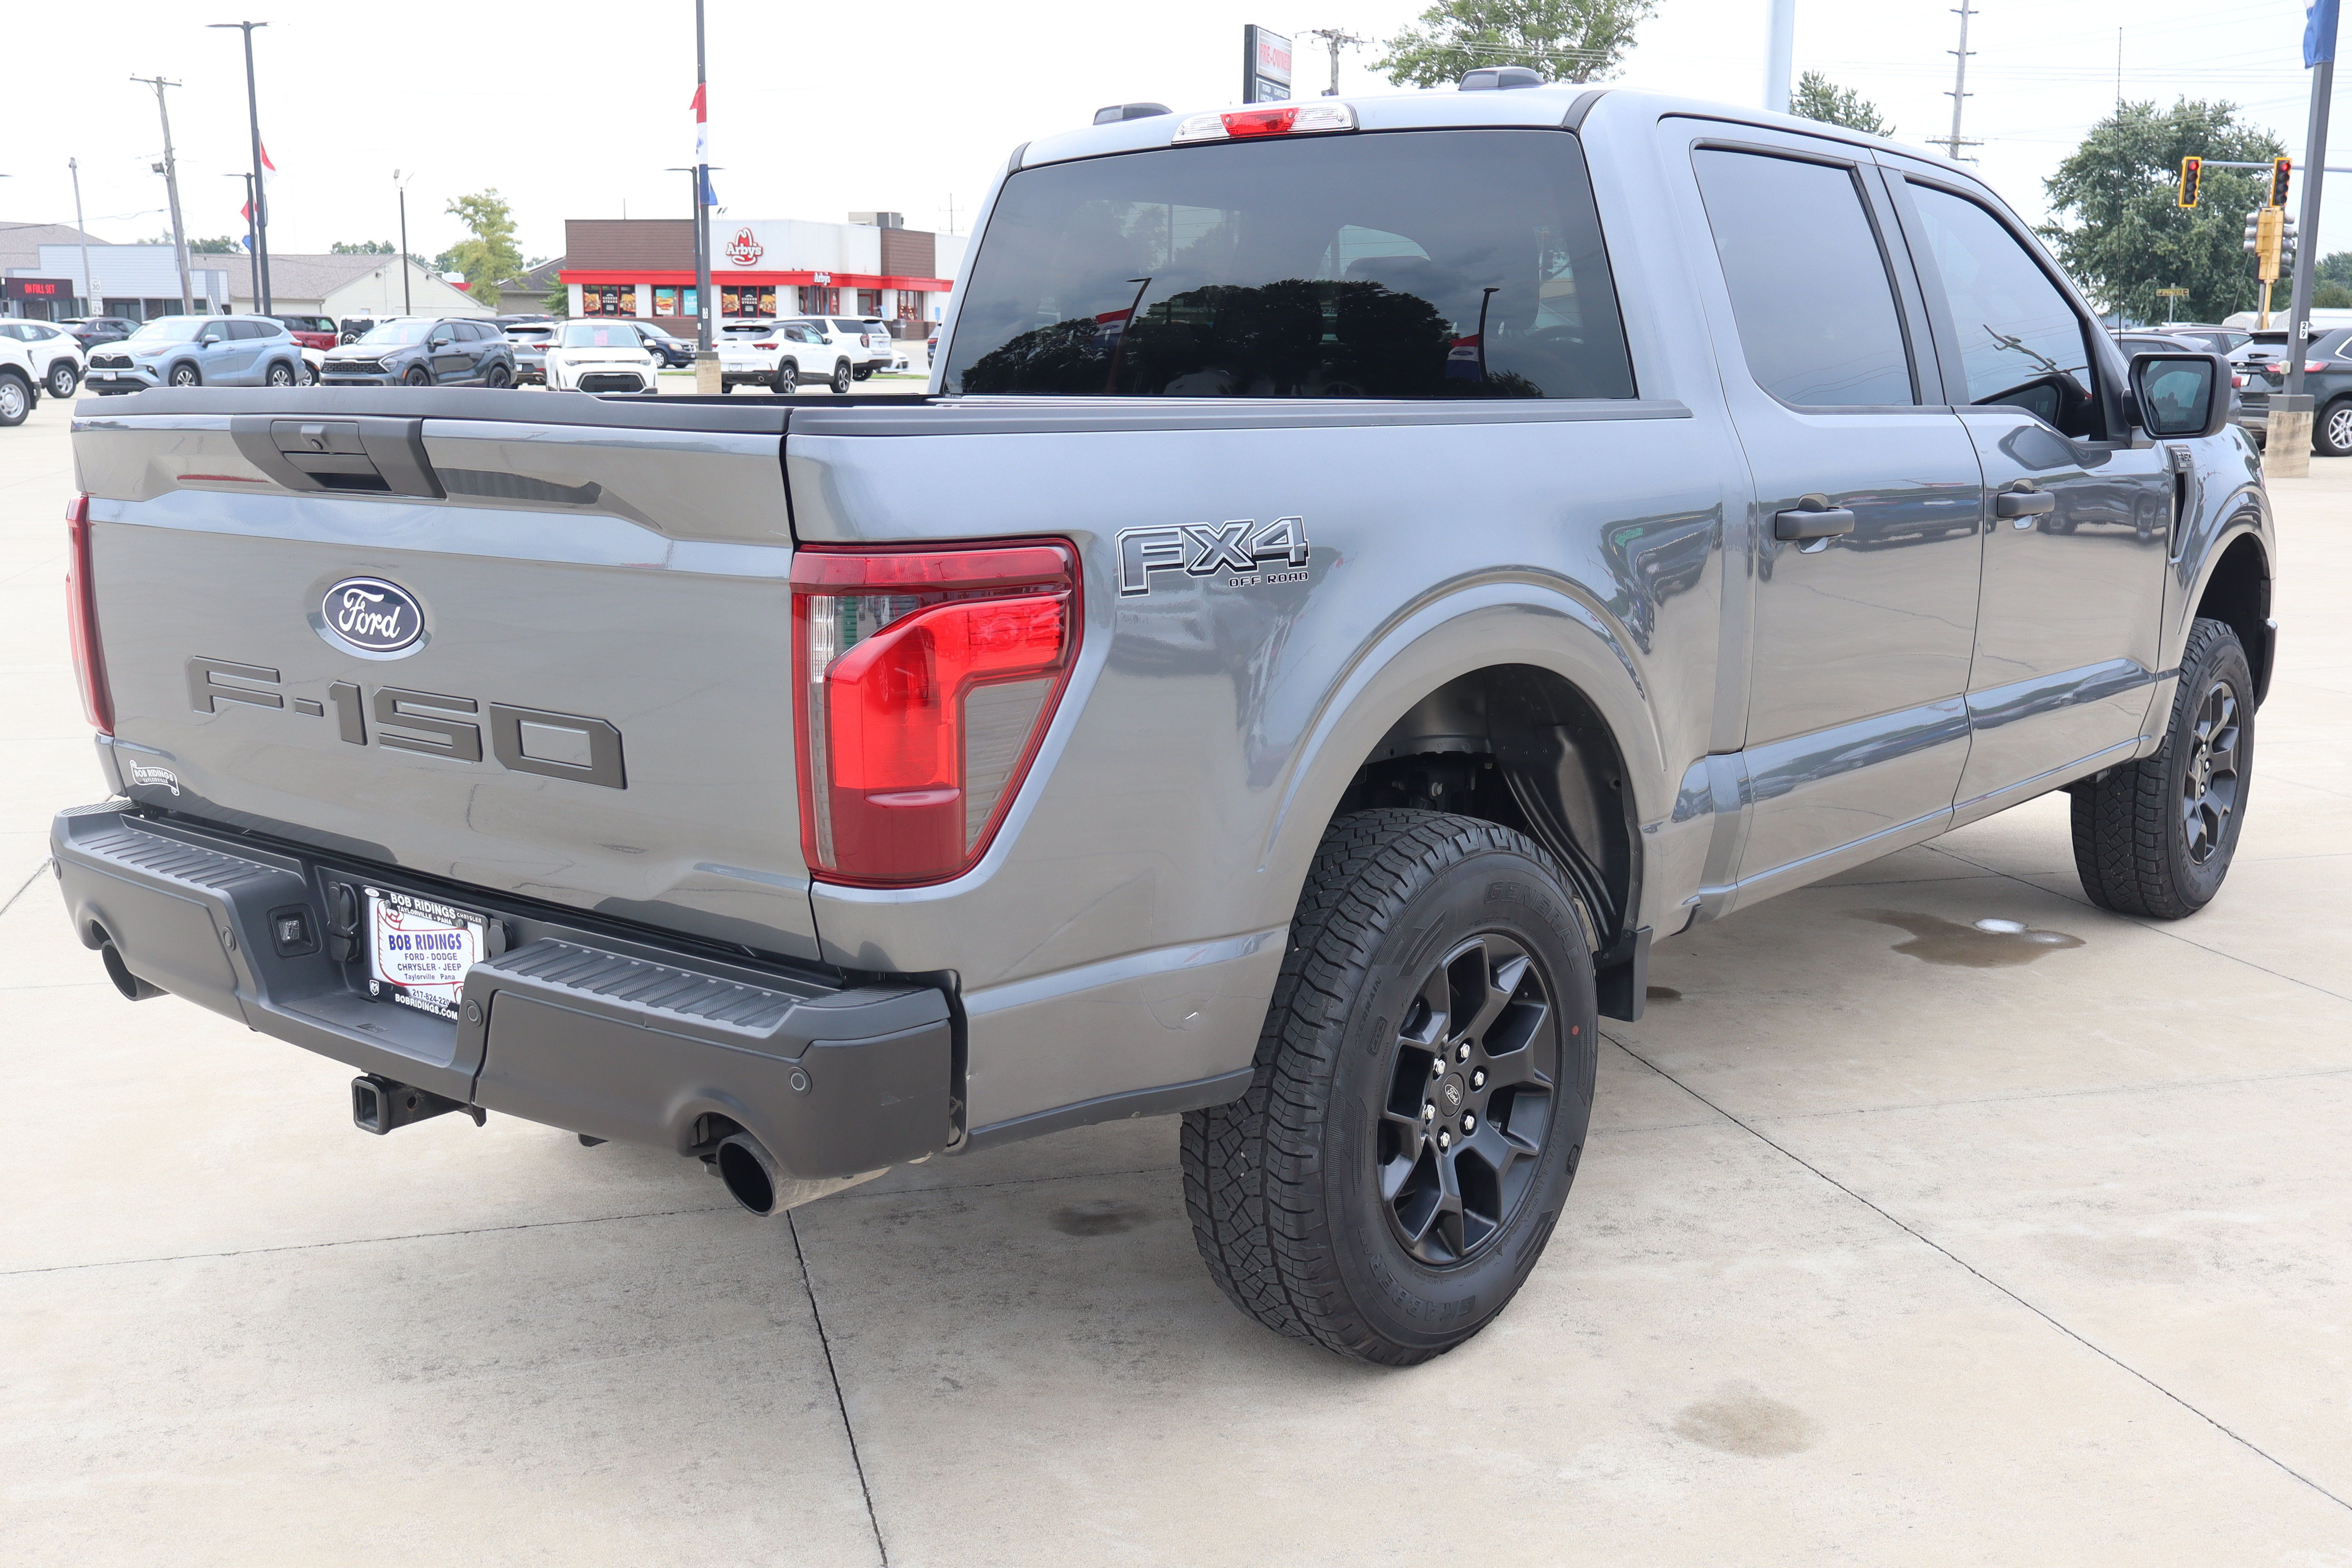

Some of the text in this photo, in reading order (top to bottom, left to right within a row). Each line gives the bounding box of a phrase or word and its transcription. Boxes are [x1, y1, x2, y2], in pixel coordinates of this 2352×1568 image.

[1260, 42, 1291, 72] PRE-OWNED
[726, 243, 762, 258] Arby's
[813, 272, 831, 286] Arby's
[33, 284, 45, 294] FULL
[45, 284, 55, 294] SET
[2301, 322, 2307, 338] 29
[1114, 516, 1310, 599] FX4
[1229, 571, 1309, 588] OFF ROAD
[338, 588, 402, 639] Ford
[187, 655, 628, 790] F-150
[134, 769, 174, 782] BOB RIDINGS
[390, 893, 456, 919] BOB RIDINGS
[397, 905, 433, 920] TAYLORVILLE
[437, 916, 453, 926] PANA
[457, 912, 482, 923] CHRYSLER
[1485, 880, 1580, 972] GENERAL
[388, 933, 462, 951] BOB RIDINGS
[404, 973, 435, 981] Taylorville
[395, 993, 458, 1020] BOBRIDINGS.COM
[1447, 1087, 1459, 1103] Ford
[1369, 1251, 1476, 1321] GRABBER
